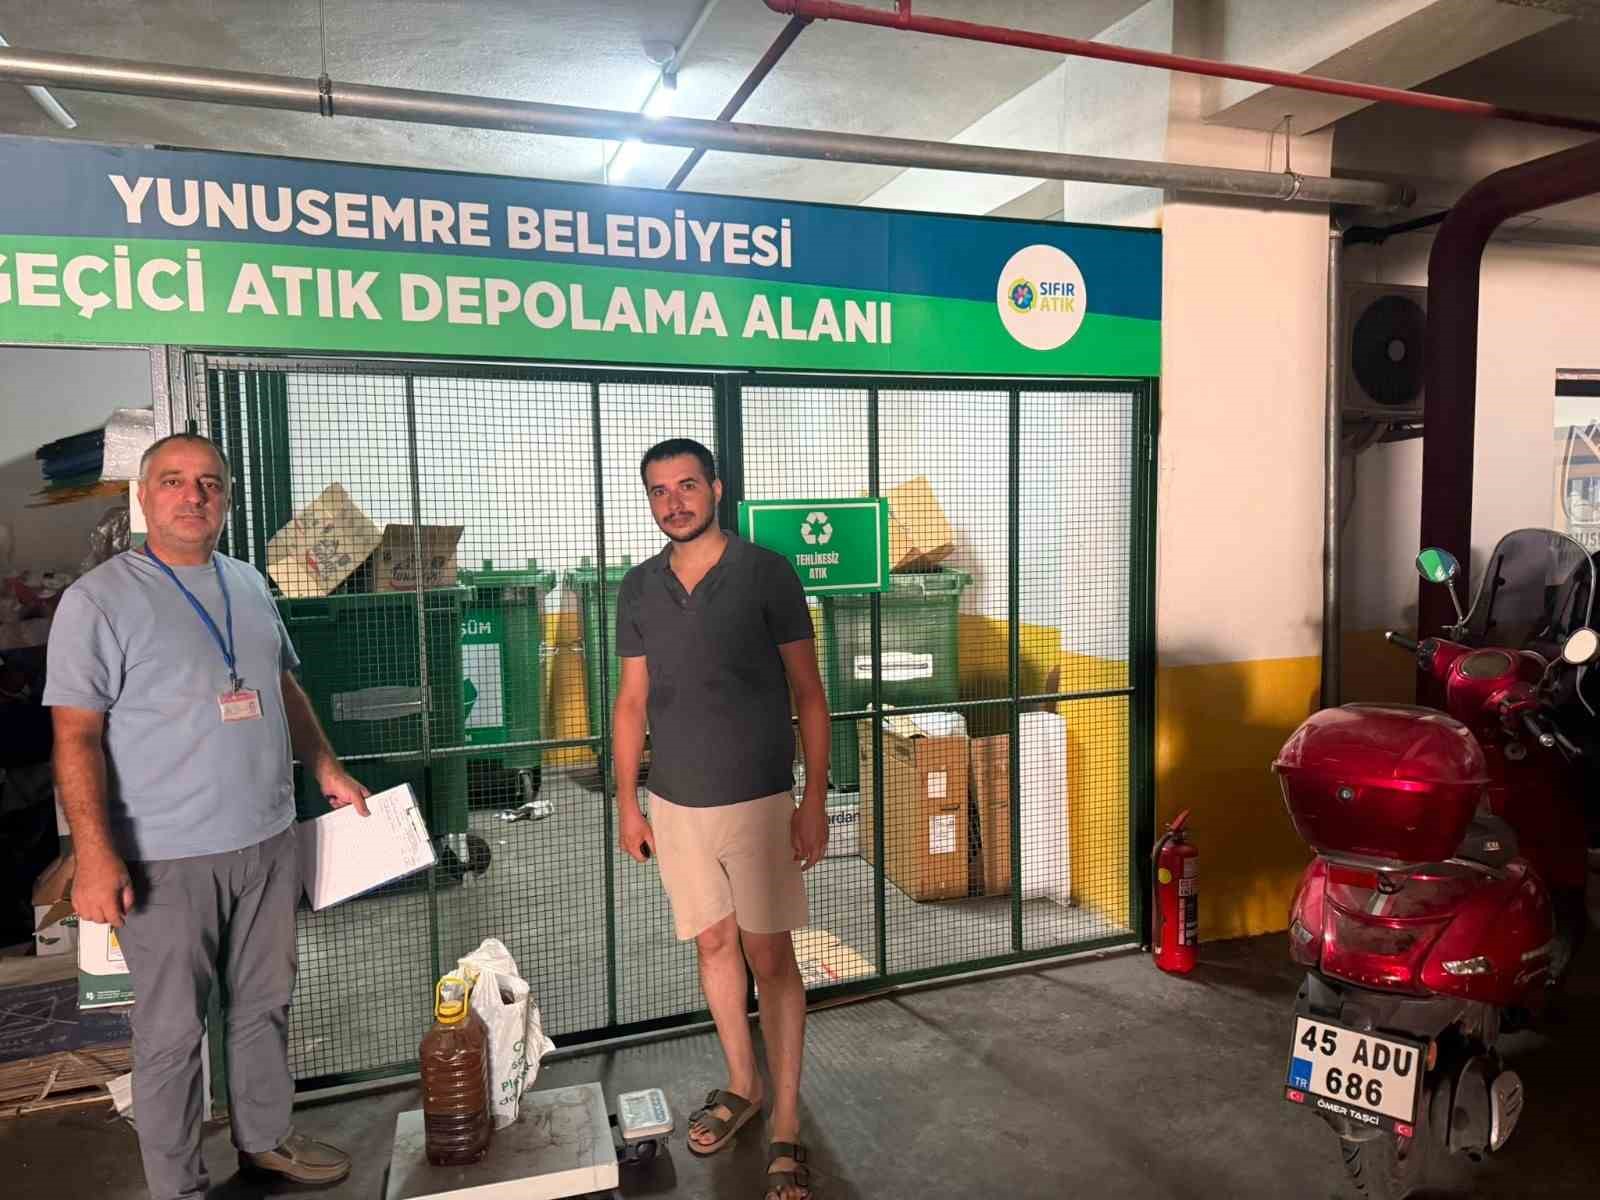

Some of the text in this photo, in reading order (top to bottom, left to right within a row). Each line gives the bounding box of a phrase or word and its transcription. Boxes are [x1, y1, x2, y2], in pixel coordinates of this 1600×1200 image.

[107, 174, 791, 268] YUNUSEMRE BELEDİYESİ
[0, 244, 891, 343] EÇİCİ ATIK DEPOLAMA ALANI
[1040, 281, 1075, 297] SIFIR
[1040, 297, 1074, 312] ATIK
[796, 551, 840, 567] TEHLİKESİZ
[809, 567, 828, 580] ATIK
[1301, 1025, 1413, 1077] 45 ADU
[1295, 1077, 1308, 1088] TR
[1326, 1067, 1384, 1107] 686
[1317, 1099, 1348, 1115] ÖMER
